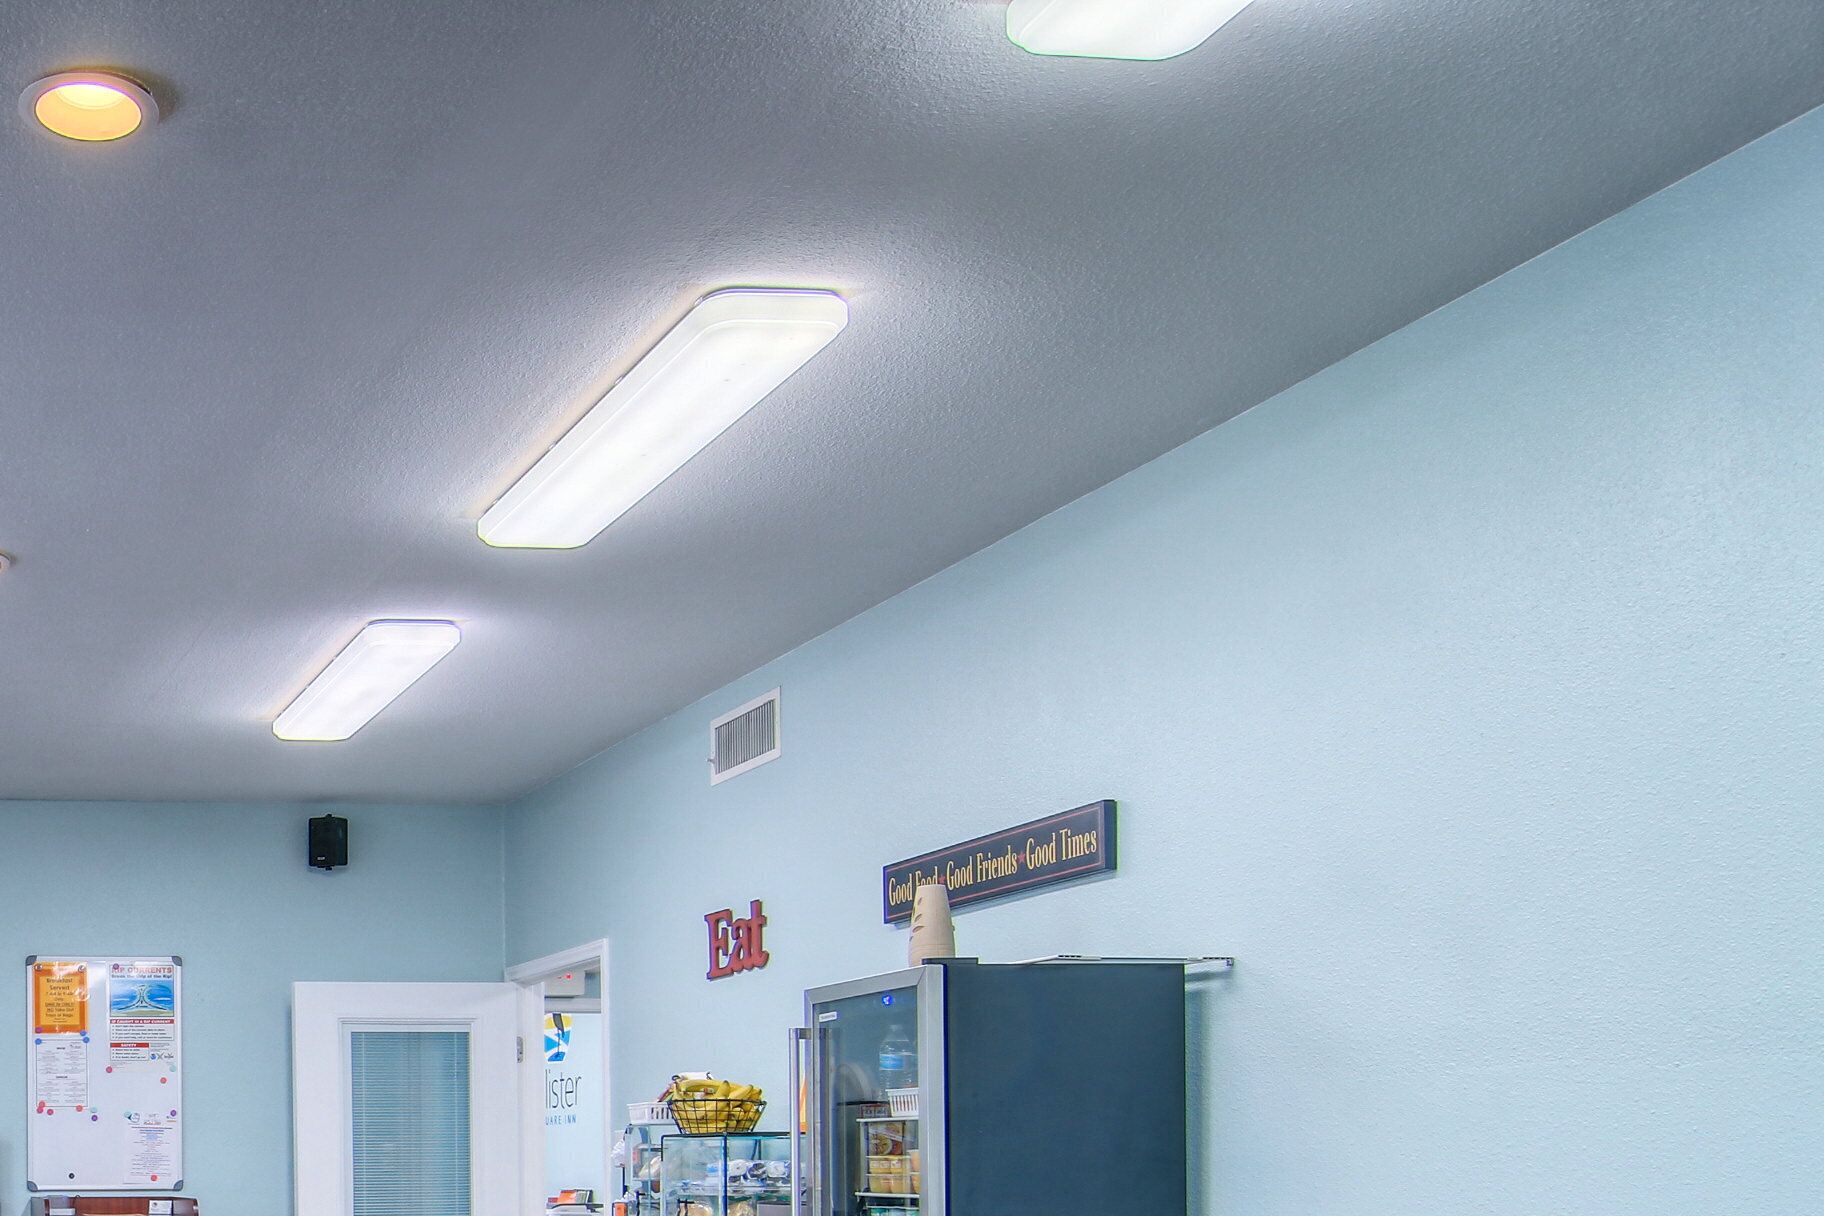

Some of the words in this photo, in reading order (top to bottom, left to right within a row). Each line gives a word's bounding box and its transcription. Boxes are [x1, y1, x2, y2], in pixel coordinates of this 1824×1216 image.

[889, 873, 913, 907] Good
[946, 856, 973, 891] Good
[977, 844, 1018, 882] Friends
[1026, 832, 1056, 870] Good
[1060, 827, 1097, 862] Times
[703, 899, 770, 980] Eat
[545, 1069, 582, 1109] lister
[545, 1116, 562, 1126] UARE
[564, 1115, 577, 1124] INN
